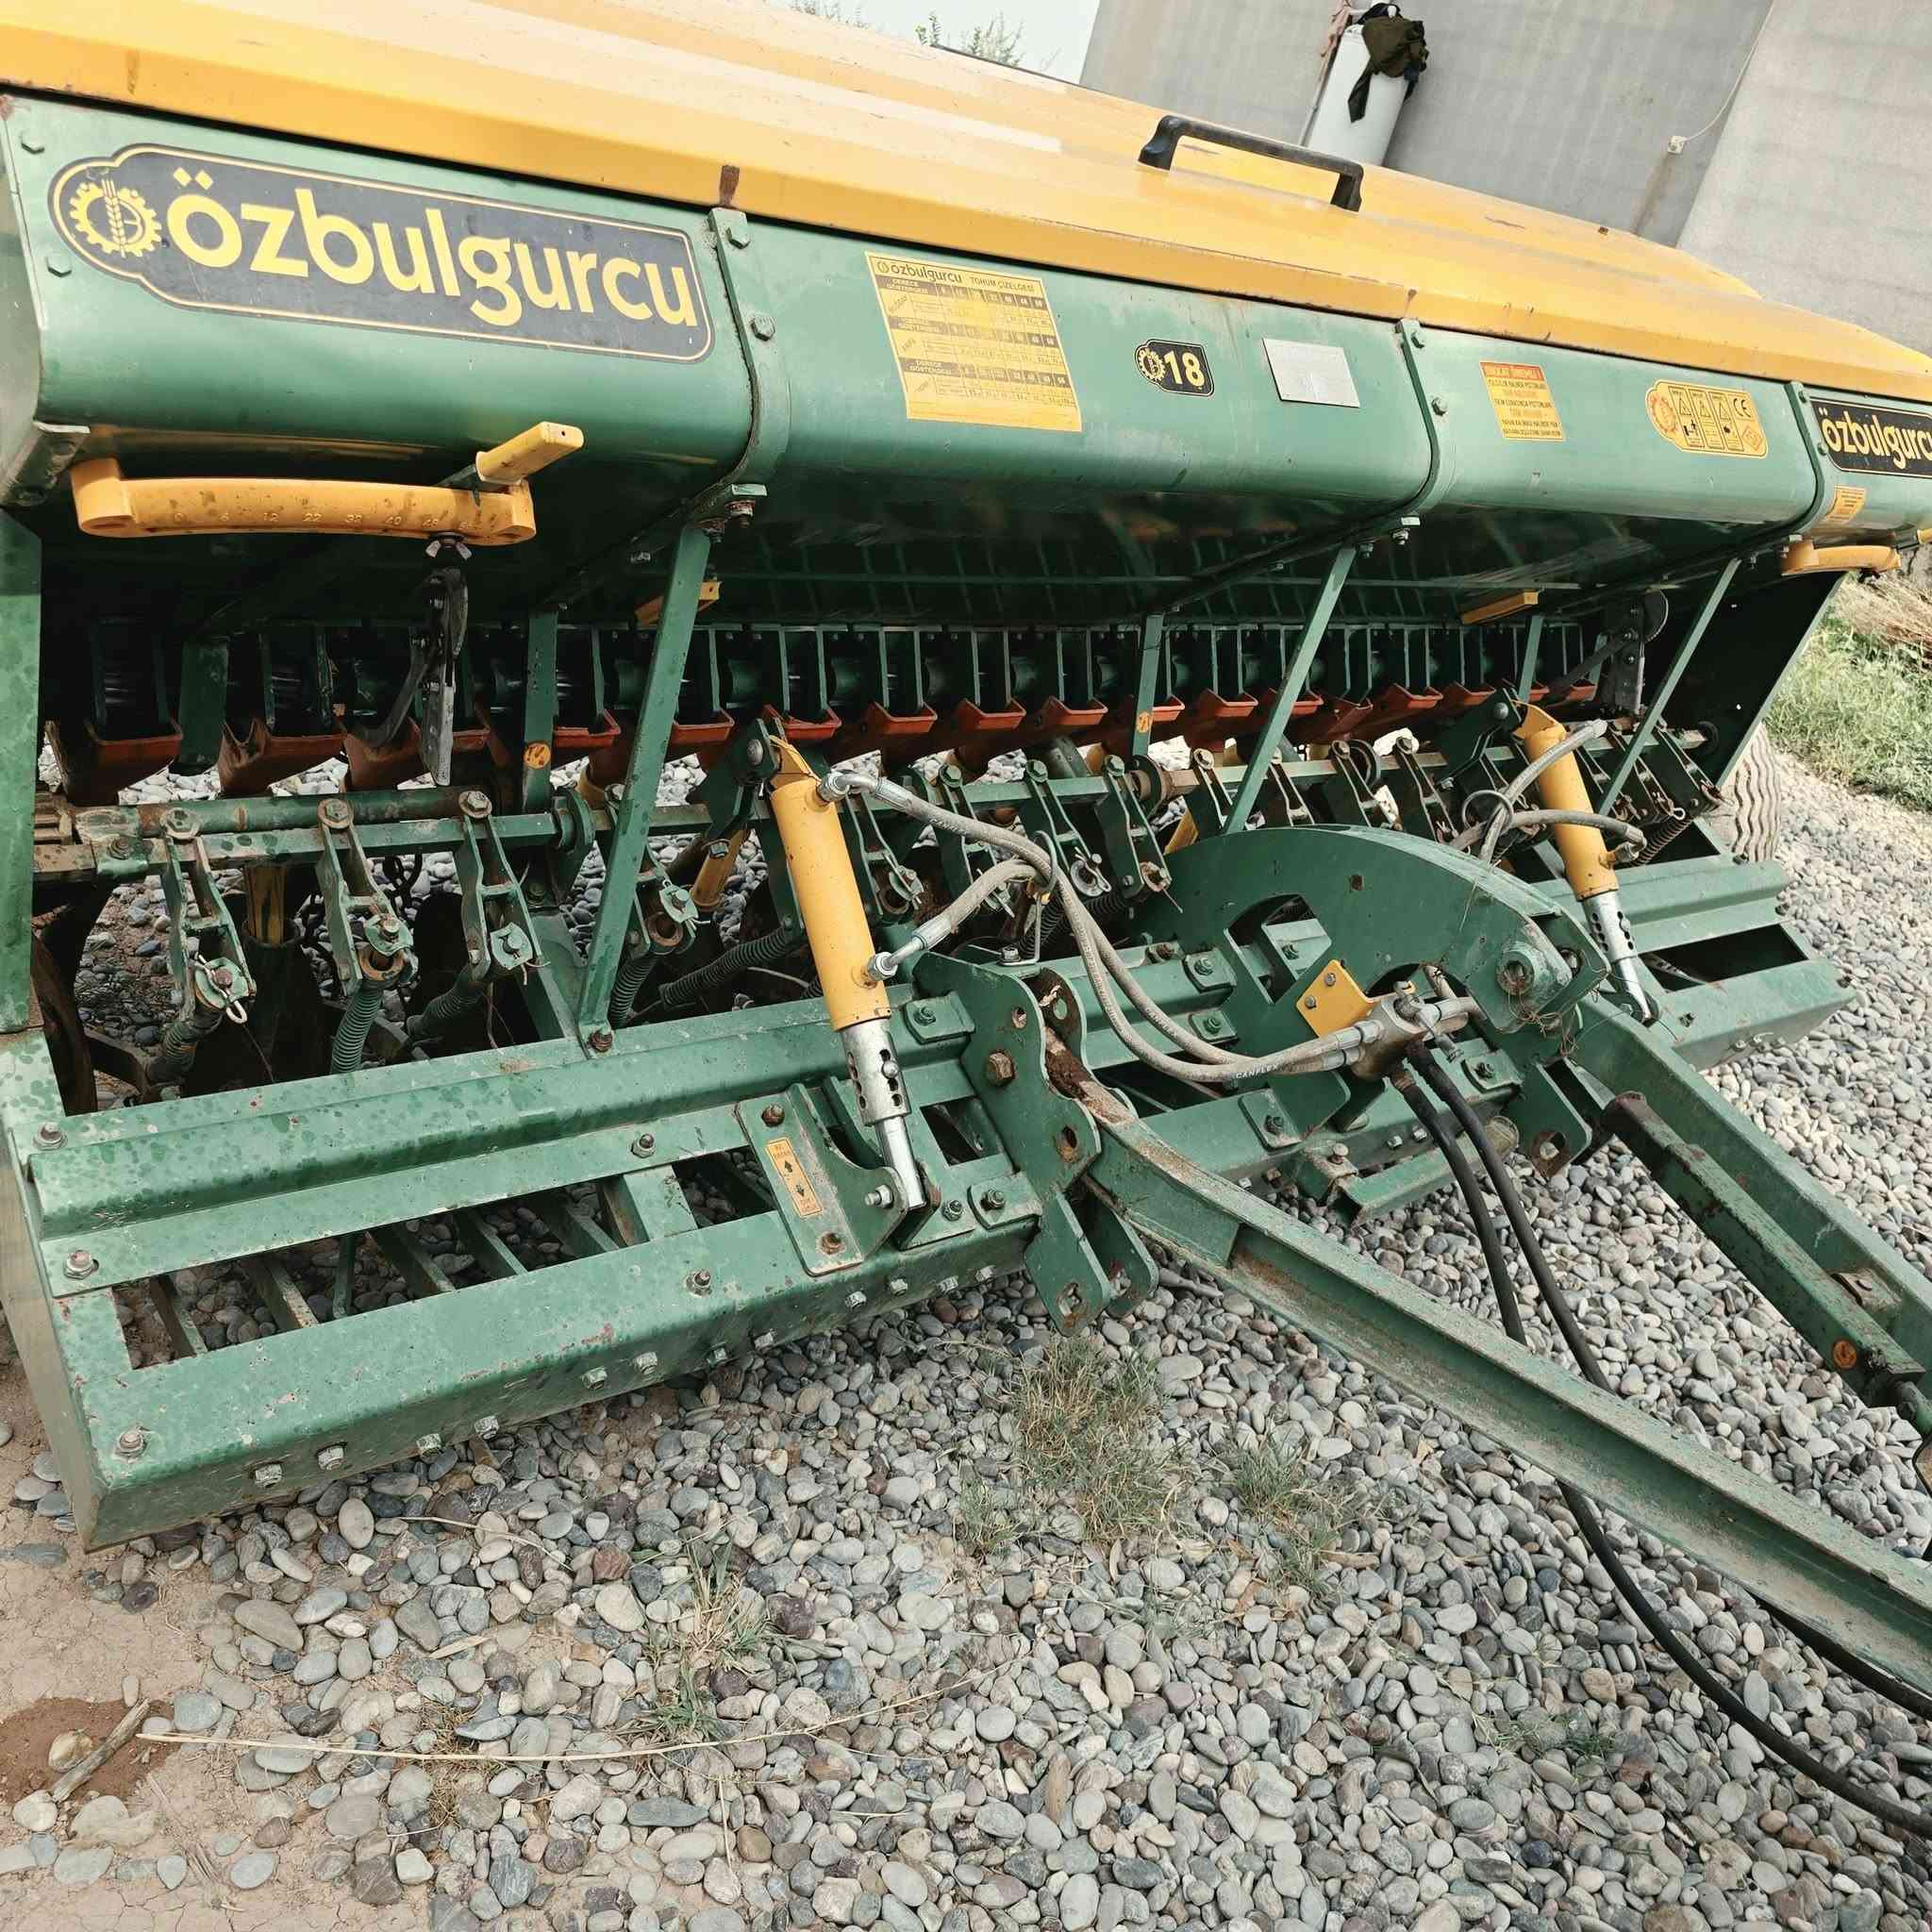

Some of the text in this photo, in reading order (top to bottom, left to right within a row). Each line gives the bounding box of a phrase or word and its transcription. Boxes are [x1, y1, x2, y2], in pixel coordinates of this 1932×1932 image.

[167, 167, 698, 327] özbulgurcu
[1163, 350, 1205, 387] 18
[1818, 407, 1932, 469] özbulgurc
